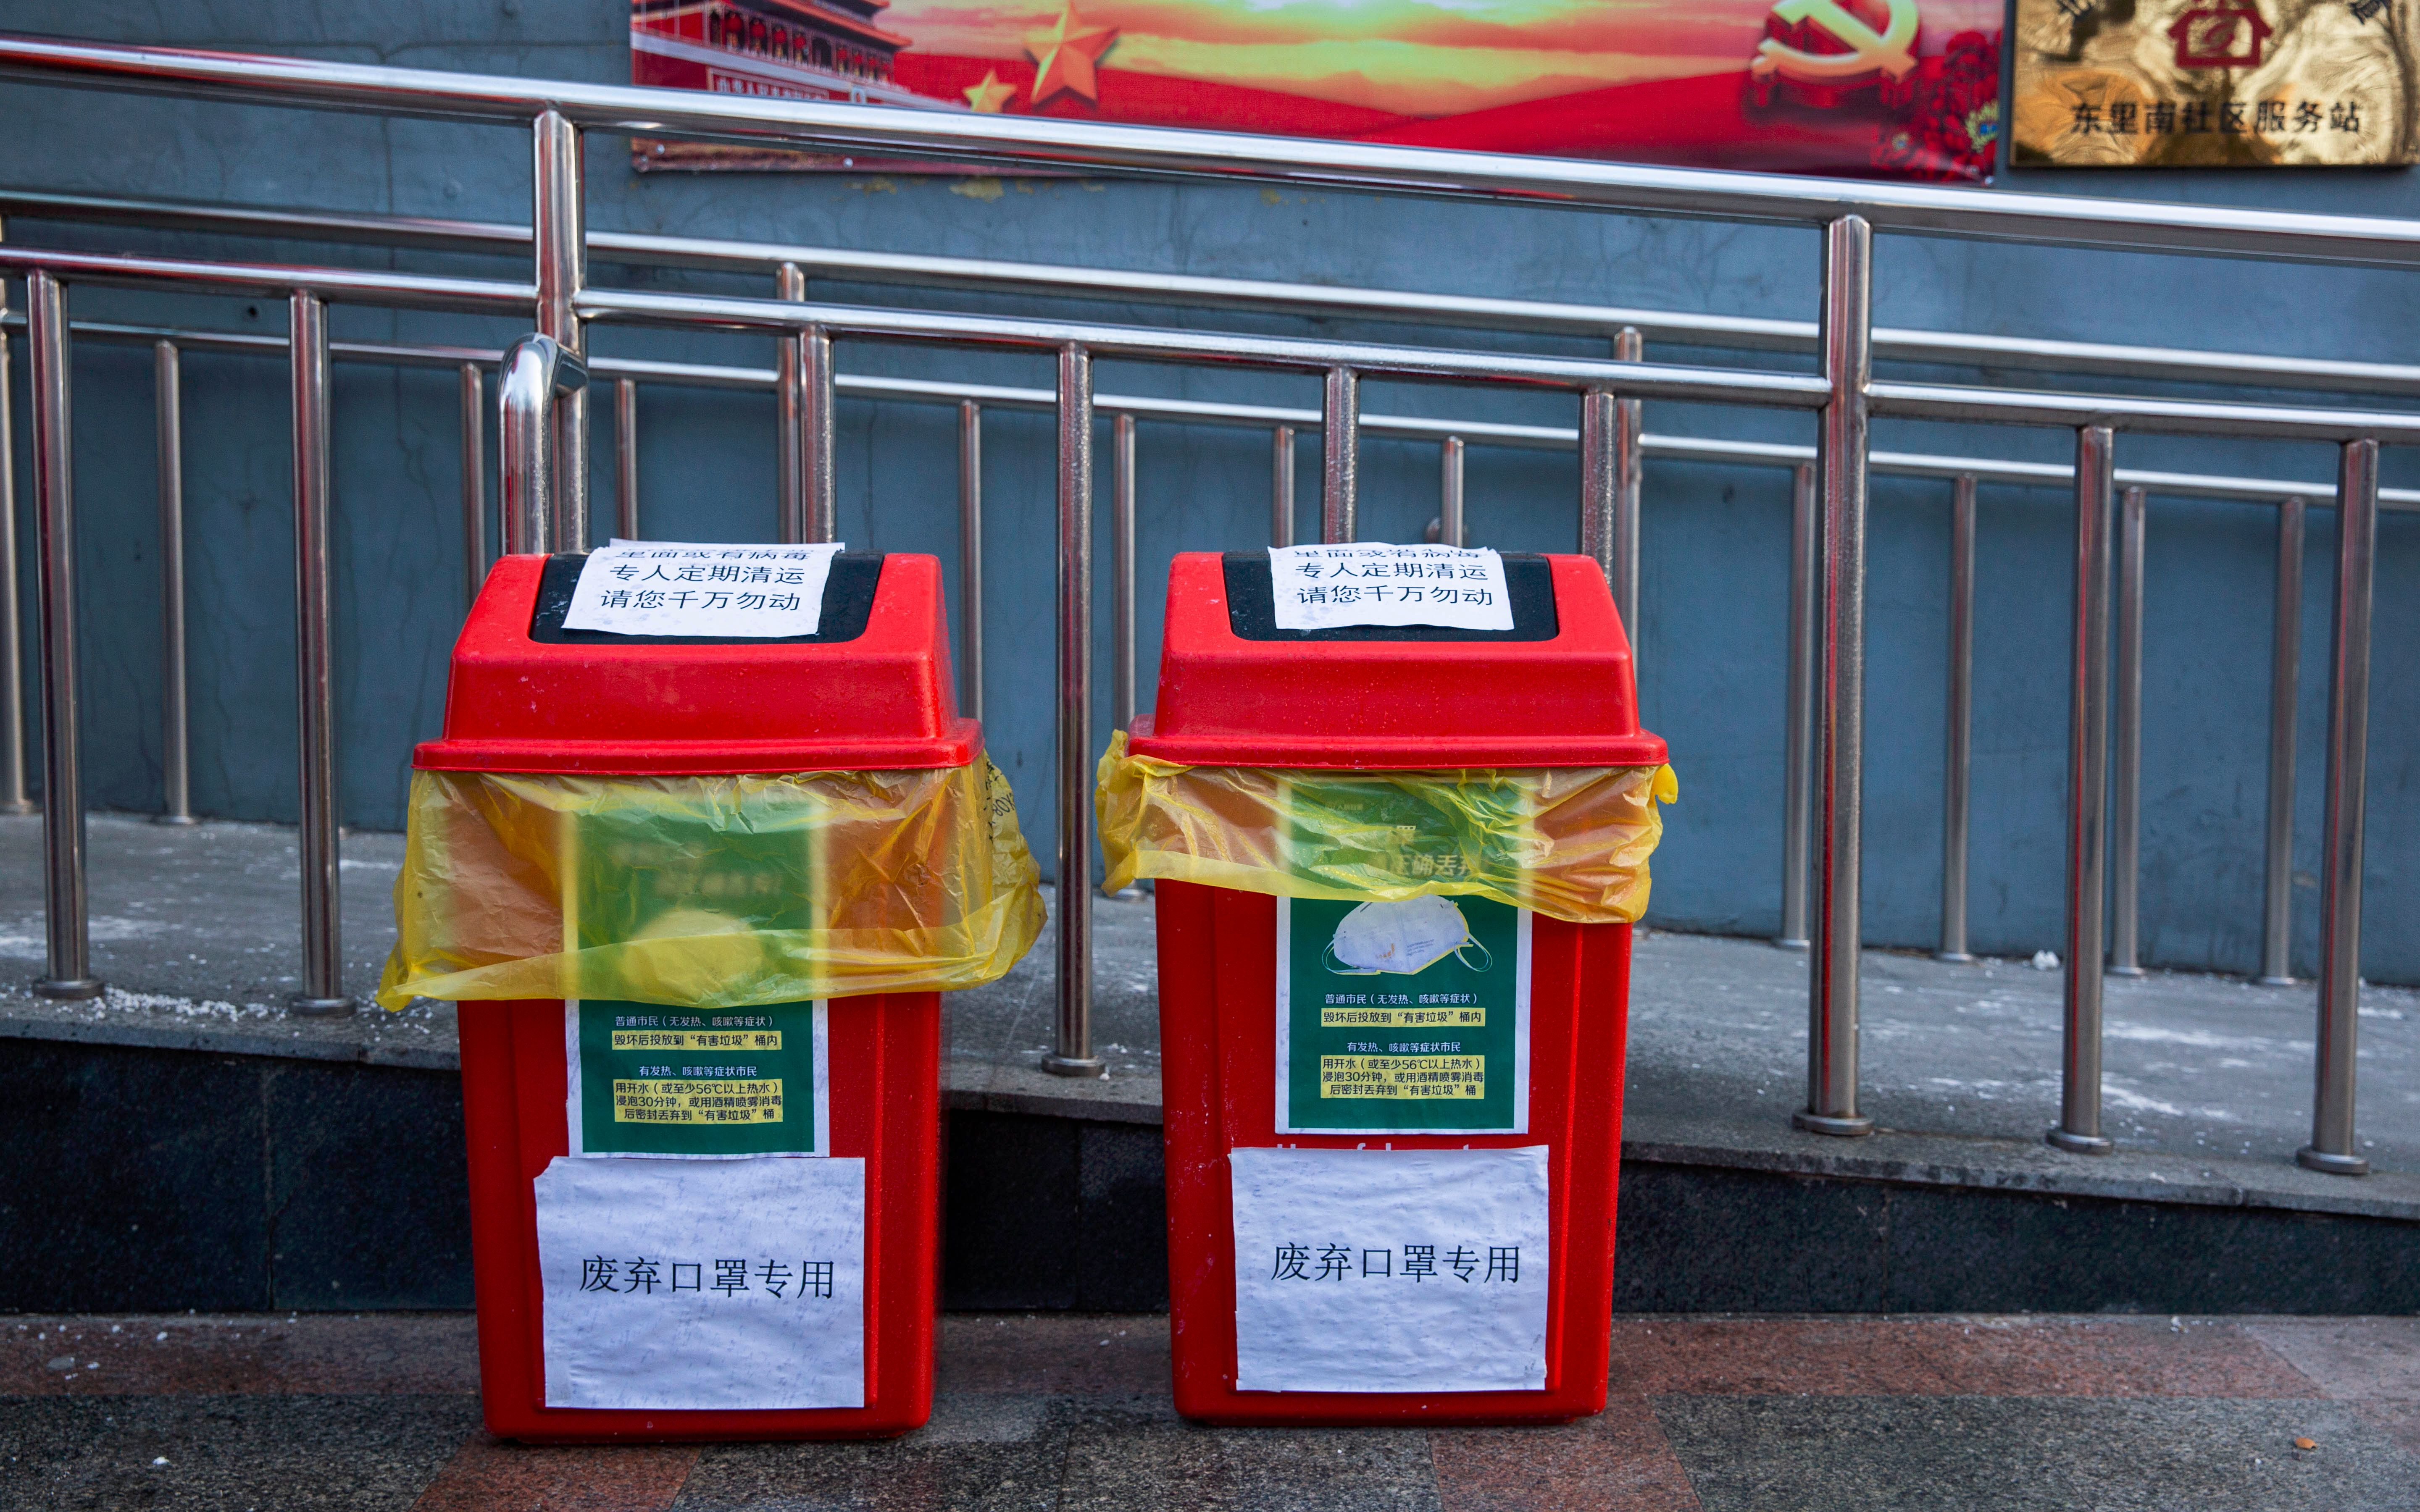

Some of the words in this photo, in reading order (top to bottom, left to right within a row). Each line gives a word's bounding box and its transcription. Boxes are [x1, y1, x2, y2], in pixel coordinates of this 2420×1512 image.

[2070, 102, 2364, 135] 东里南社区服务站
[609, 564, 805, 584] 专人定期清运
[1296, 562, 1489, 580] 专人定期清运
[600, 589, 801, 612] 请您千万勿动
[1297, 585, 1493, 606] 请您千万勿动
[1325, 993, 1478, 1005] 普通市民（无发热、咳嗽等症状）
[615, 1016, 773, 1027] 普通市民（无发热、咳嗽等症状）
[1323, 1011, 1481, 1023] 毁坏后投放到“有害垃圾”桶内
[614, 1034, 778, 1046] 毁坏后投放到“有害垃圾”桶内
[1347, 1042, 1461, 1053] 有发热、咳嗽等症状市民
[639, 1066, 758, 1077] 有发热、咳嗽等症状市民
[1322, 1071, 1484, 1083] 浸泡30分钟，或用酒精喷雾消毒
[1330, 1084, 1476, 1096] 后密封丢弃到“有害垃圾”桶
[616, 1095, 782, 1108] 浸泡30分钟，或用酒精喷雾消毒
[623, 1108, 775, 1121] 后密封丢弃到“有害垃圾”桶
[1270, 1242, 1520, 1284] 废弃口罩专用
[579, 1254, 835, 1299] 废弃口罩专用
